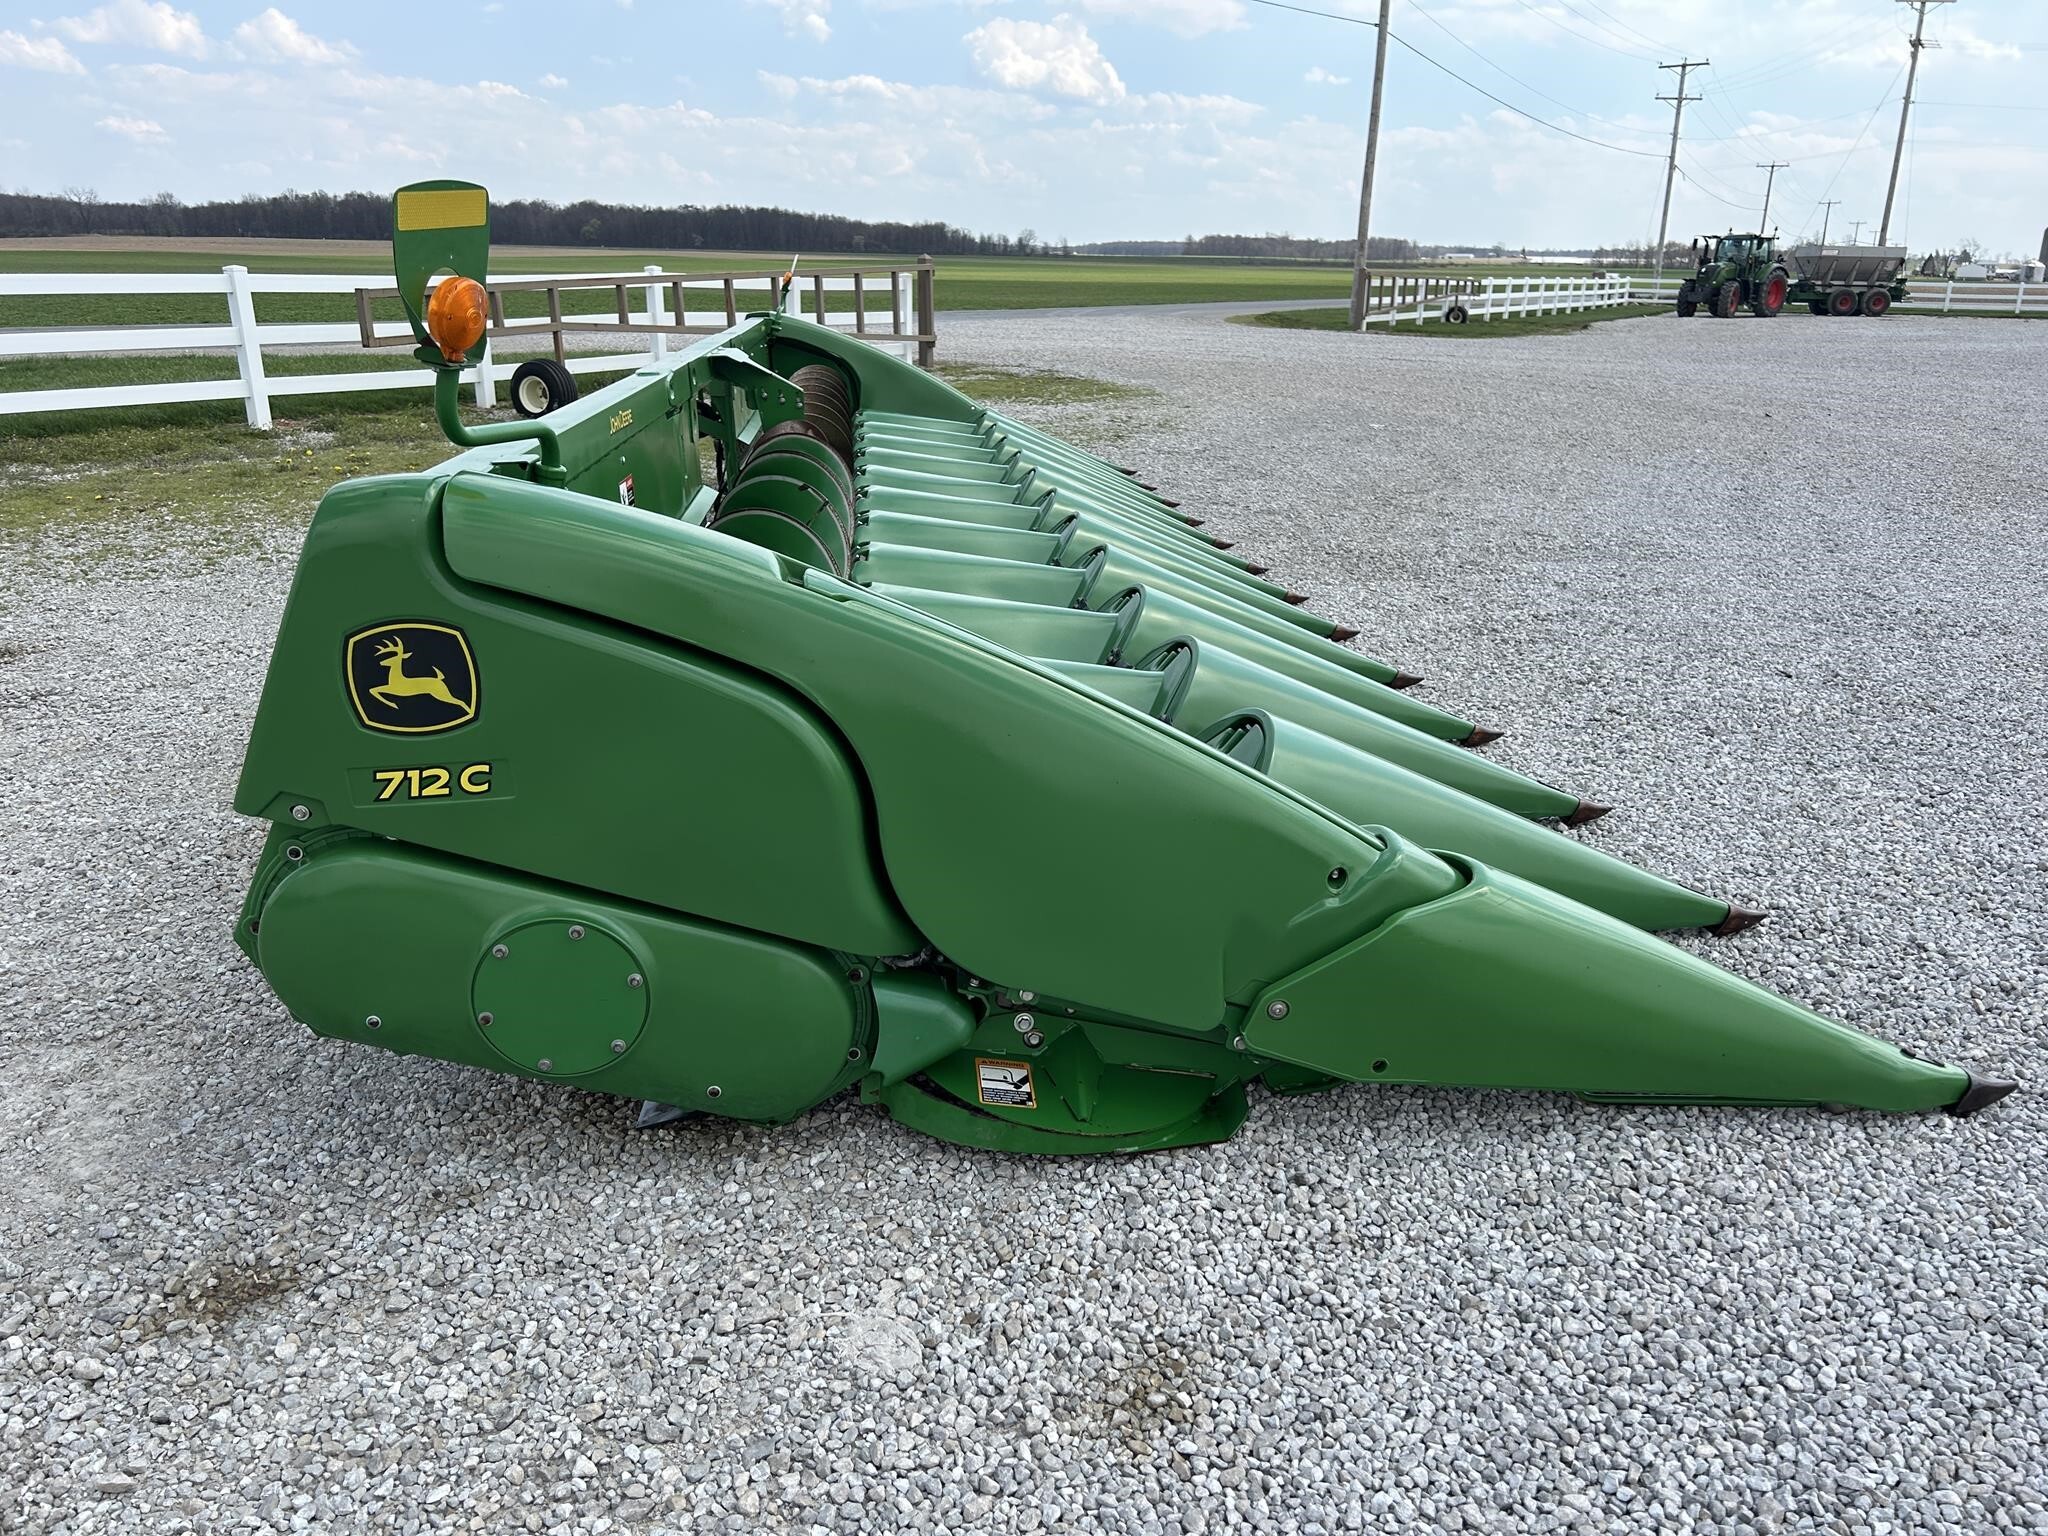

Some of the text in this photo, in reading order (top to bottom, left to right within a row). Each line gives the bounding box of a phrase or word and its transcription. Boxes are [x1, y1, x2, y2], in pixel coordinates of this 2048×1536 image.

[374, 763, 491, 800] 712 C
[988, 1060, 1025, 1068] WARNING
